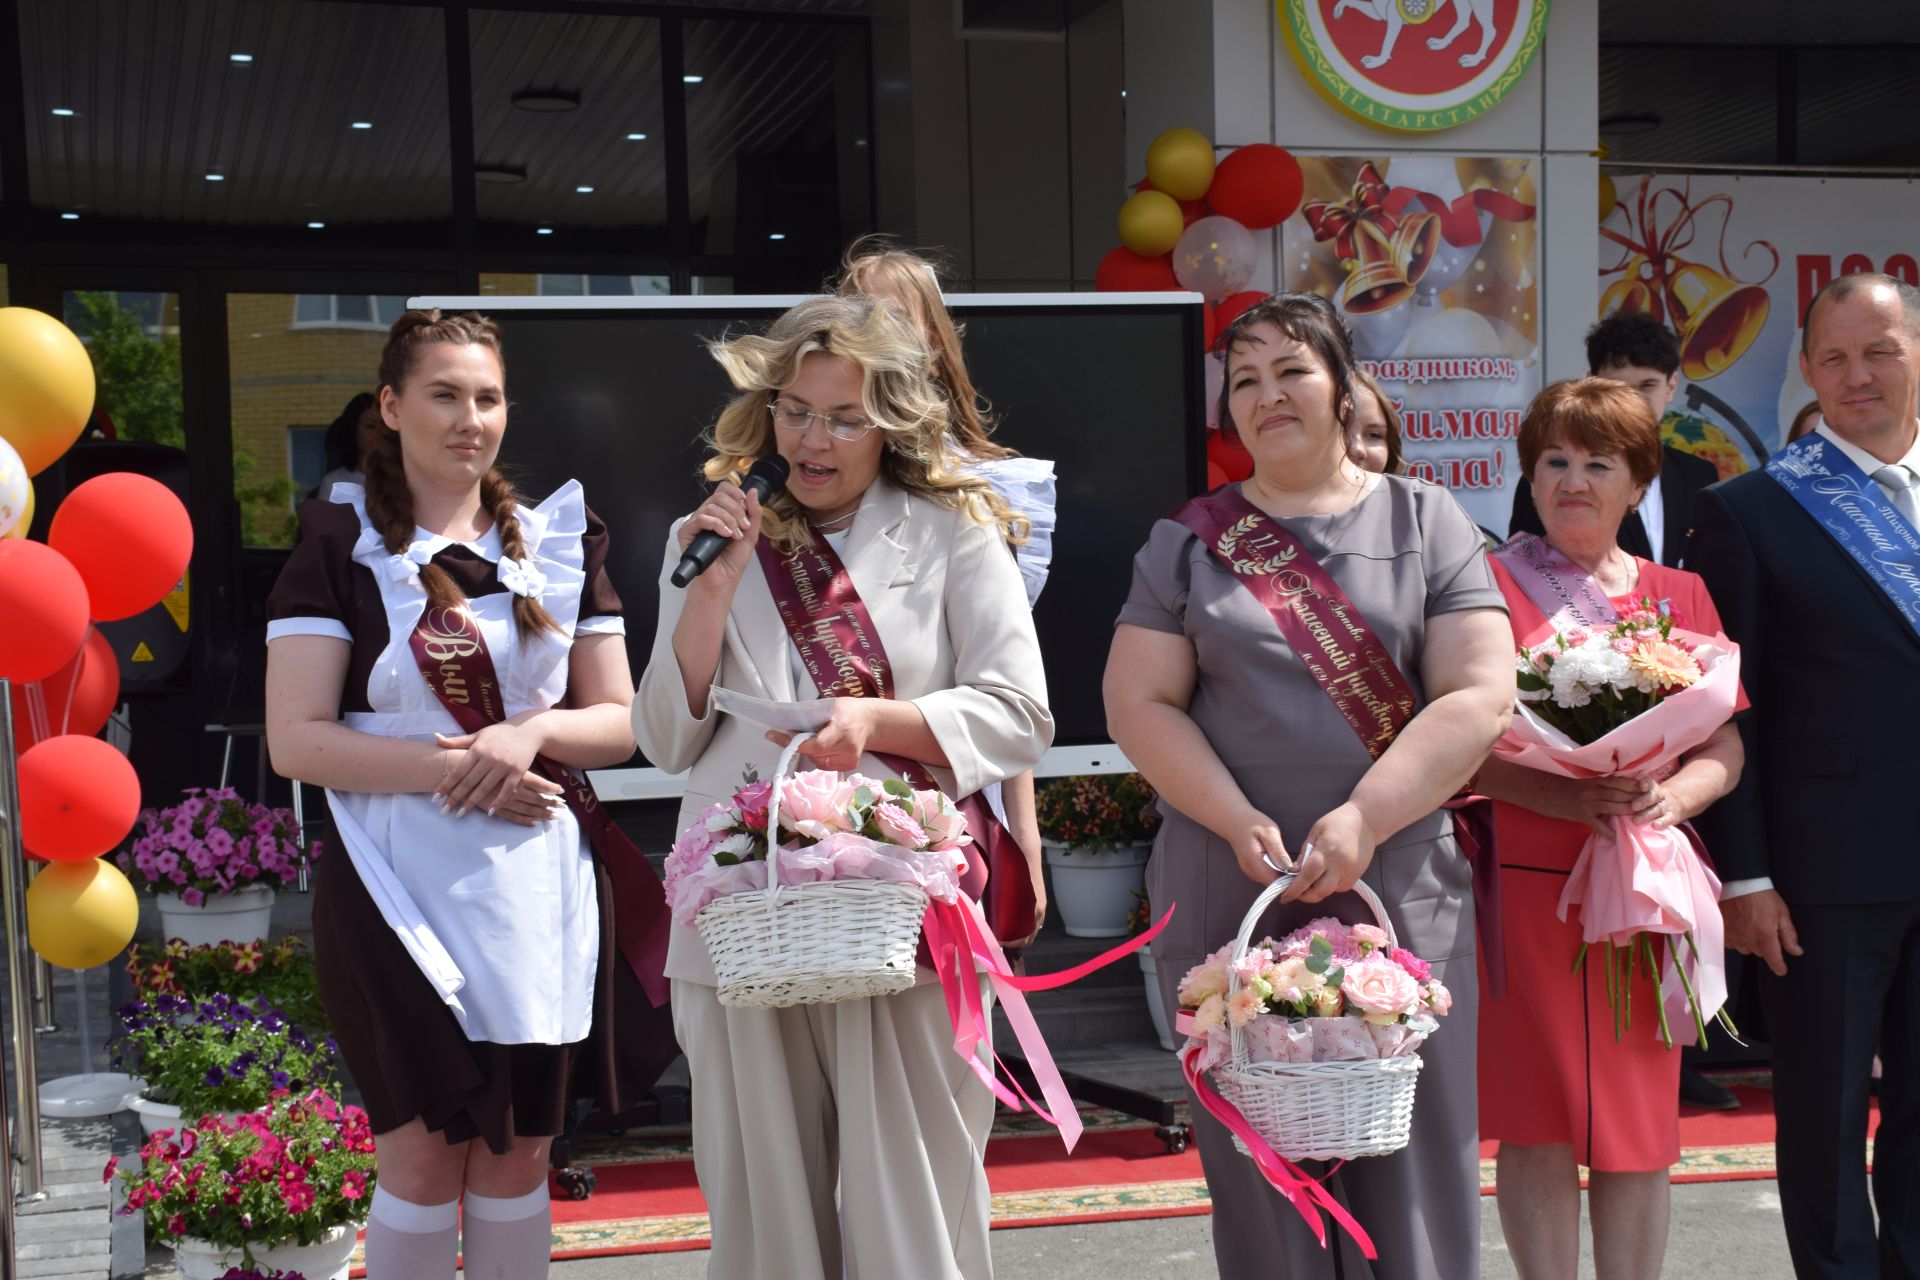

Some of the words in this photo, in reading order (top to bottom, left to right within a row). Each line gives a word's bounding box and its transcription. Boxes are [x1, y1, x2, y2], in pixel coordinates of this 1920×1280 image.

[1348, 91, 1495, 127] ТАТАРСТАН
[1364, 357, 1517, 384] раздником,
[1391, 399, 1521, 440] имая
[1407, 448, 1504, 488] ола!
[1811, 473, 1901, 552] Классный
[1250, 532, 1280, 549] 11
[1271, 569, 1357, 671] Классный
[417, 605, 483, 705] Вып
